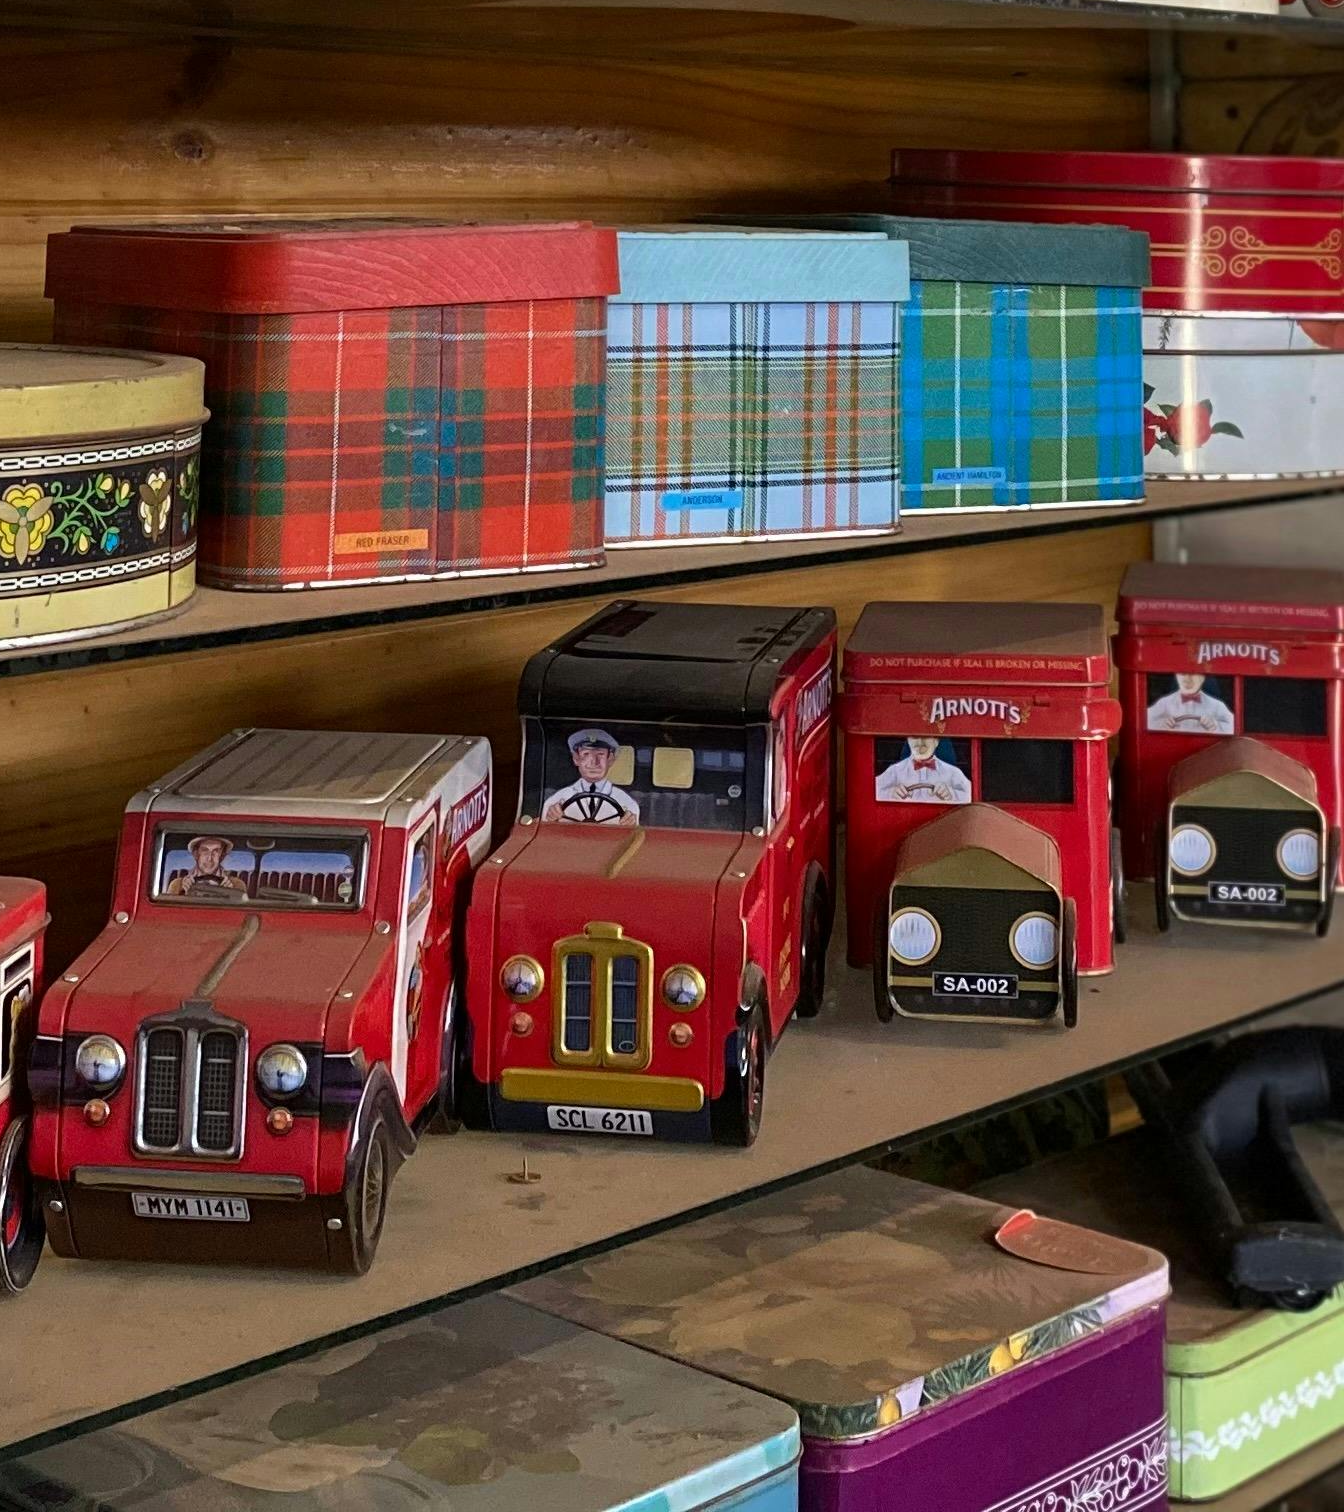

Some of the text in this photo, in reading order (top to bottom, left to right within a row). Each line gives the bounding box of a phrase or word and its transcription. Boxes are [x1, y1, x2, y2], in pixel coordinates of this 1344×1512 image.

[682, 494, 723, 505] ANDERSON
[356, 535, 410, 548] RED FRASER
[870, 658, 883, 667] DO
[884, 658, 905, 667] NOT
[907, 658, 952, 668] PURCHASE
[954, 659, 962, 668] IF
[963, 659, 984, 669] SEAL
[986, 659, 994, 668] IS
[995, 659, 1030, 669] BROKEN
[1032, 660, 1046, 670] OR
[929, 696, 1022, 725] ARNOTT'S
[1217, 886, 1278, 902] SA-002
[943, 976, 1009, 995] SA-002
[556, 1108, 645, 1132] SCL 6211
[146, 1196, 235, 1217] MYM 1141
